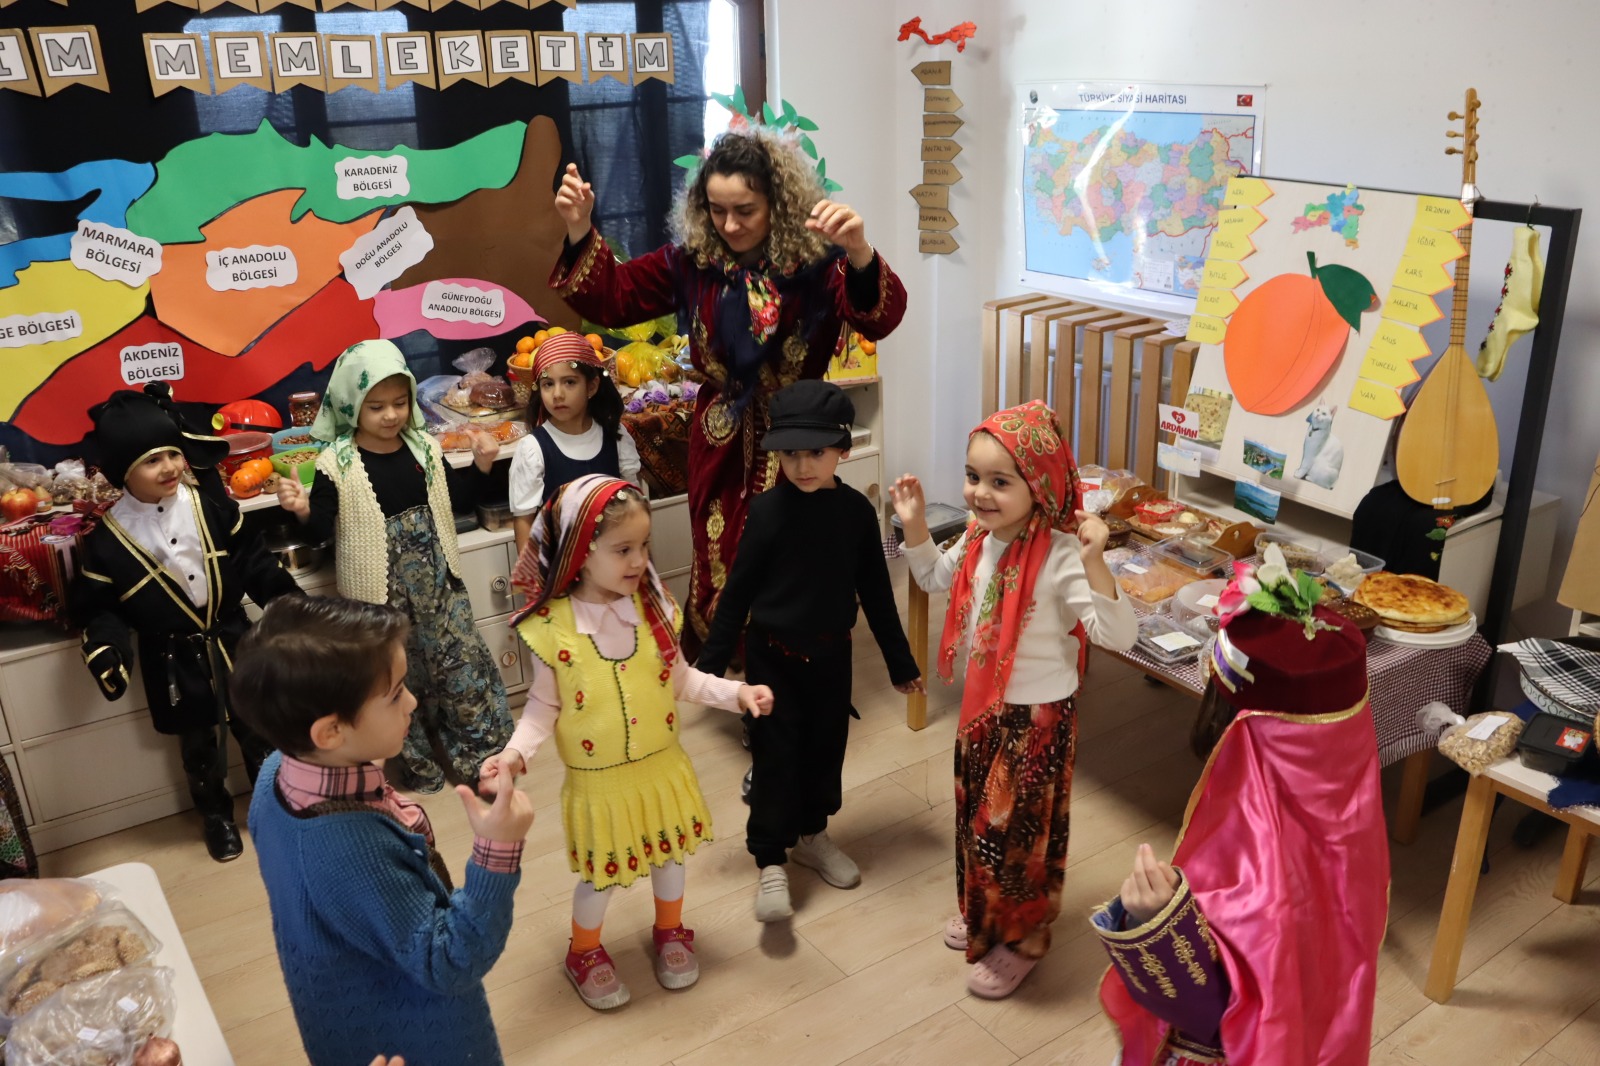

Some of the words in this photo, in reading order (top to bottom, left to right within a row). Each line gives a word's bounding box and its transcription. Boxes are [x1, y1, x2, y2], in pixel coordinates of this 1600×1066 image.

[155, 36, 665, 76] MEMLEKETİM
[1079, 92, 1117, 103] TÜRKİYE
[1117, 92, 1143, 103] SİYASİ
[1145, 93, 1186, 104] HARİTASI
[344, 164, 398, 177] KARADENİZ
[353, 178, 392, 192] BÖLGESİ
[82, 227, 154, 259] MARMARA
[355, 249, 377, 270] DOĞU
[375, 221, 408, 253] ANADOLU
[85, 248, 142, 274] BÖLGESİ
[218, 254, 229, 268] İÇ
[231, 251, 287, 265] ANADOLU
[374, 241, 403, 268] BÖLGESİ
[232, 269, 278, 282] BÖLGESİ
[1405, 268, 1423, 278] KARS
[441, 291, 492, 305] GÜNEYDOĞU
[428, 303, 468, 315] ANADOLU
[469, 308, 502, 319] BÖLGESİ
[18, 316, 75, 336] BÖLGESİ
[123, 346, 179, 362] AKDENİZ
[128, 363, 180, 381] BÖLGESİ
[1360, 390, 1376, 401] VAN
[1161, 420, 1198, 439] ARDAHAN
